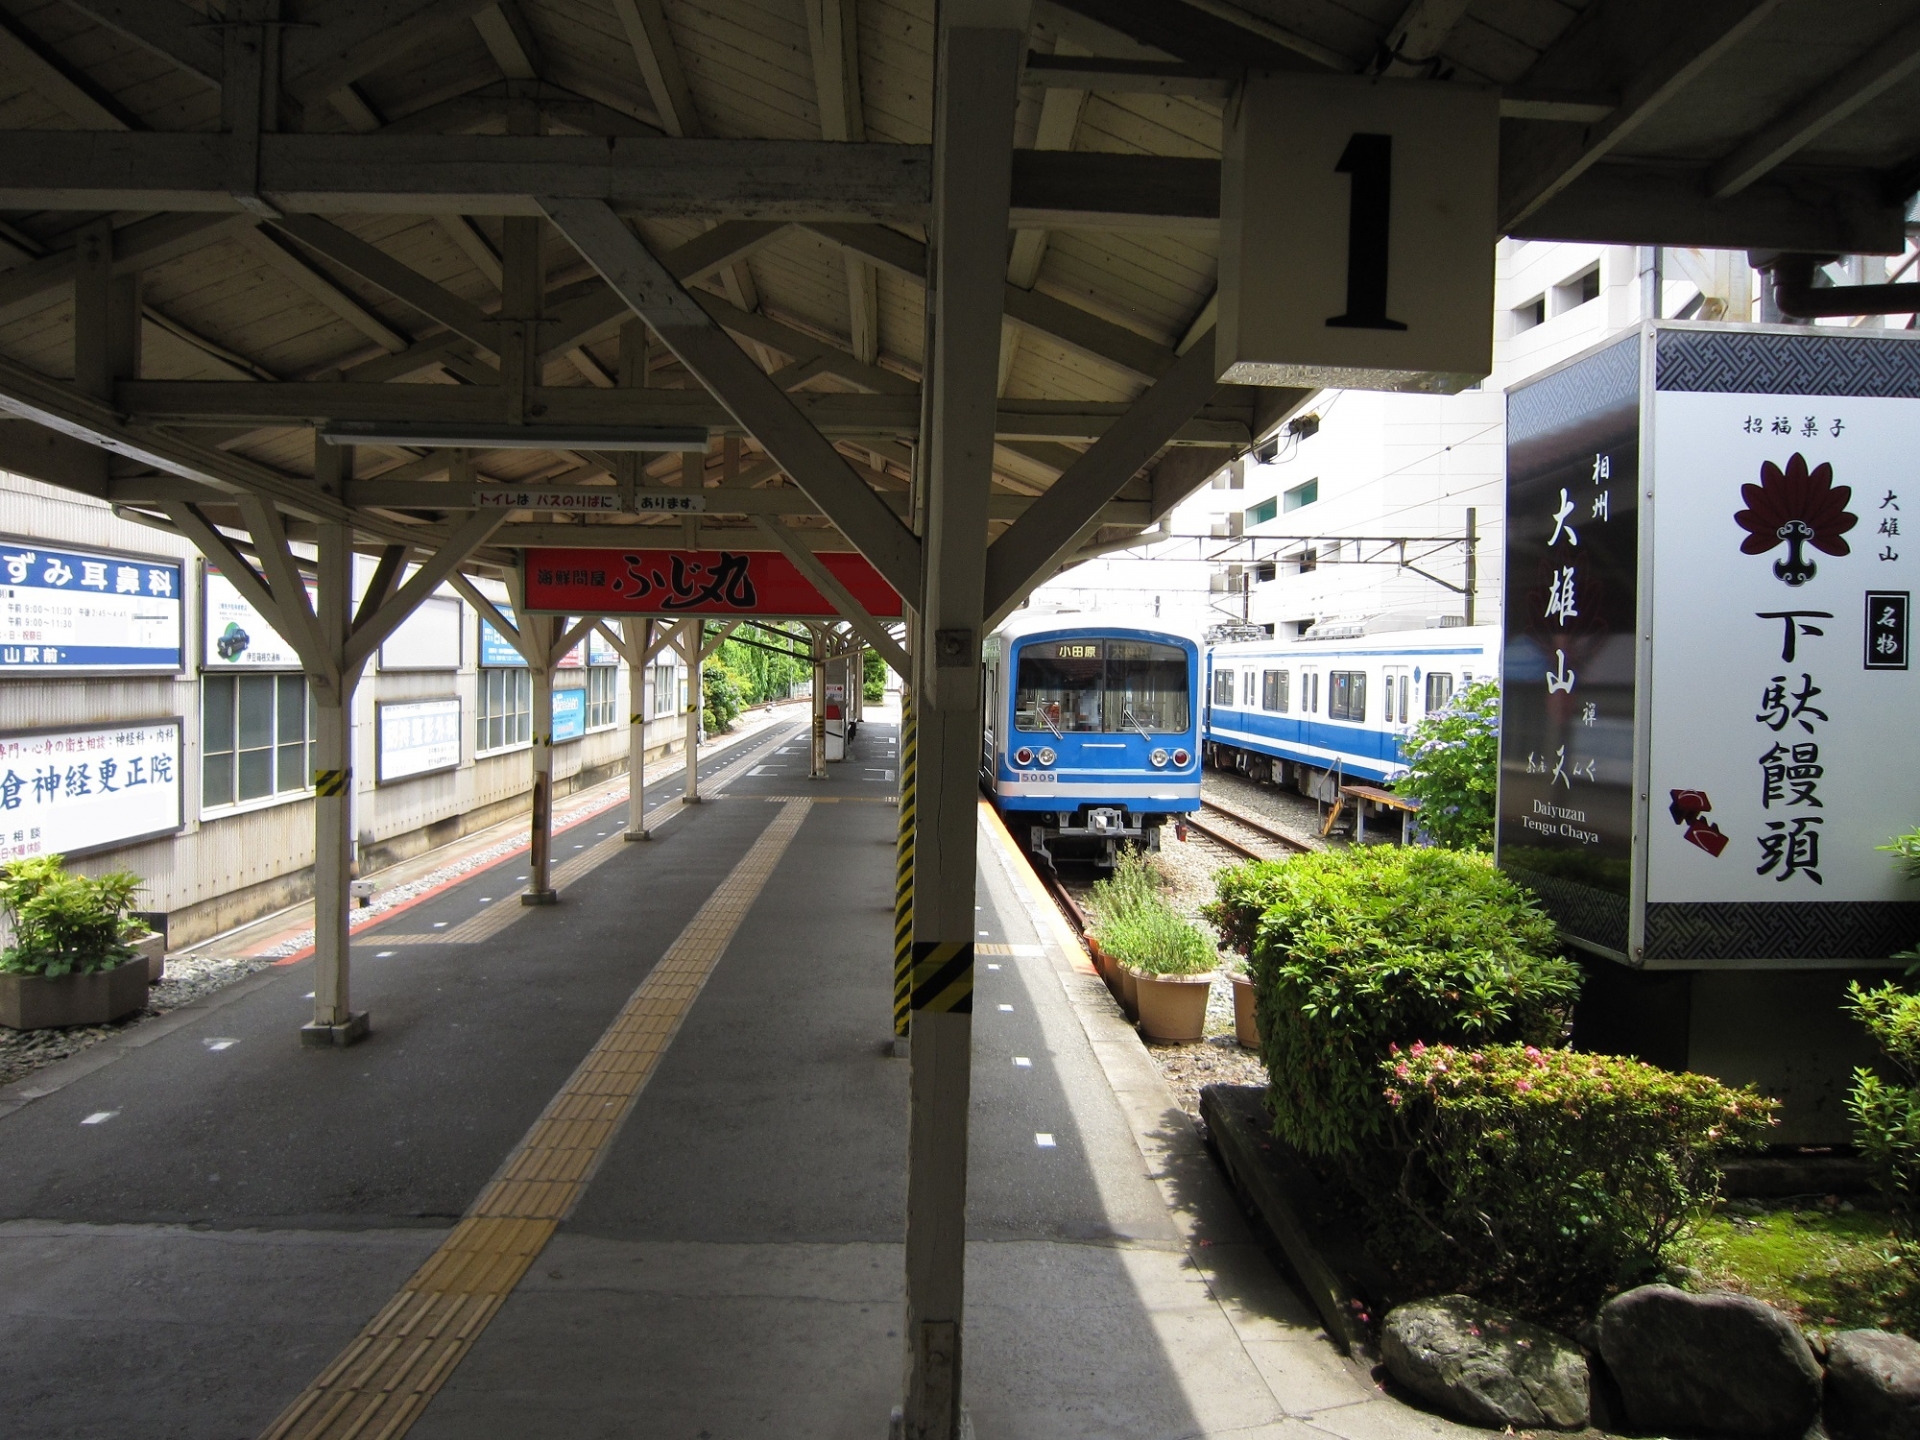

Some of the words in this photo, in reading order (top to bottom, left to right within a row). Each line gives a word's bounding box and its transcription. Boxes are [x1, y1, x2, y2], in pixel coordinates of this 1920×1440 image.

[1325, 132, 1408, 331] 1
[1743, 415, 1846, 438] 招福菓子
[480, 493, 530, 506] トイレは
[537, 494, 613, 509] バスのりばに
[641, 496, 698, 510] あります。
[1592, 453, 1610, 523] 相州
[1877, 489, 1901, 562] 大雄山
[2, 551, 172, 597] ずみ耳鼻科
[537, 568, 606, 587] 海鮮問屋
[612, 551, 758, 610] ふじ丸
[1544, 487, 1578, 694] 大雄山
[1059, 645, 1097, 658] 小田原
[1876, 606, 1898, 655] 名物
[1755, 610, 1834, 886] 下駄饅頭
[0, 752, 174, 811] 倉神経更正院
[1021, 773, 1056, 783] 5009
[1522, 815, 1557, 836] Tengu
[1560, 823, 1599, 844] Chaya
[1533, 799, 1585, 823] Daiyuzan
